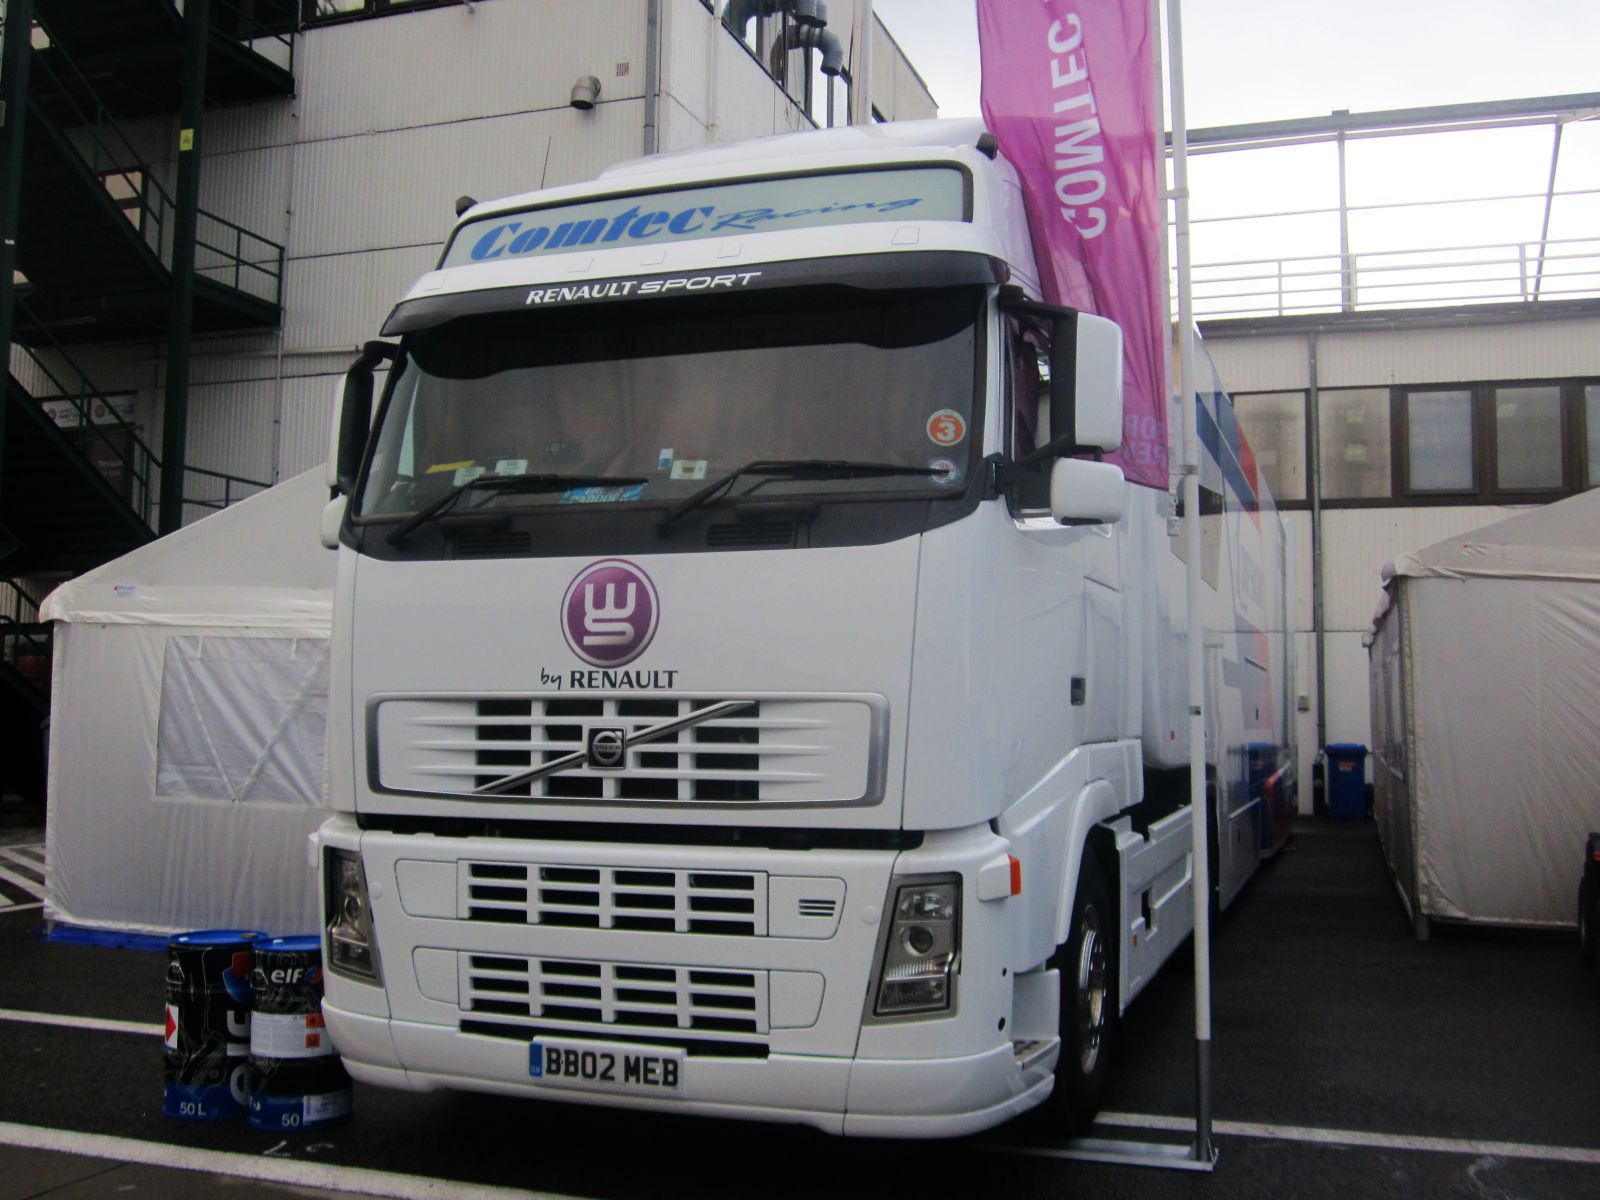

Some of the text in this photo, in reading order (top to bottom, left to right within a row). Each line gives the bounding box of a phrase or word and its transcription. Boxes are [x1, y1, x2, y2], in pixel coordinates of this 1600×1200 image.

[1048, 12, 1107, 240] COMTEC
[470, 198, 923, 262] Comtec Racing
[525, 271, 762, 305] RENAULT SPORT
[936, 421, 956, 441] 3
[540, 667, 679, 691] by RENAULT
[270, 967, 304, 984] elf
[545, 1047, 679, 1087] BB02 MEB
[179, 1101, 207, 1116] 50 L
[281, 1113, 300, 1127] 50
